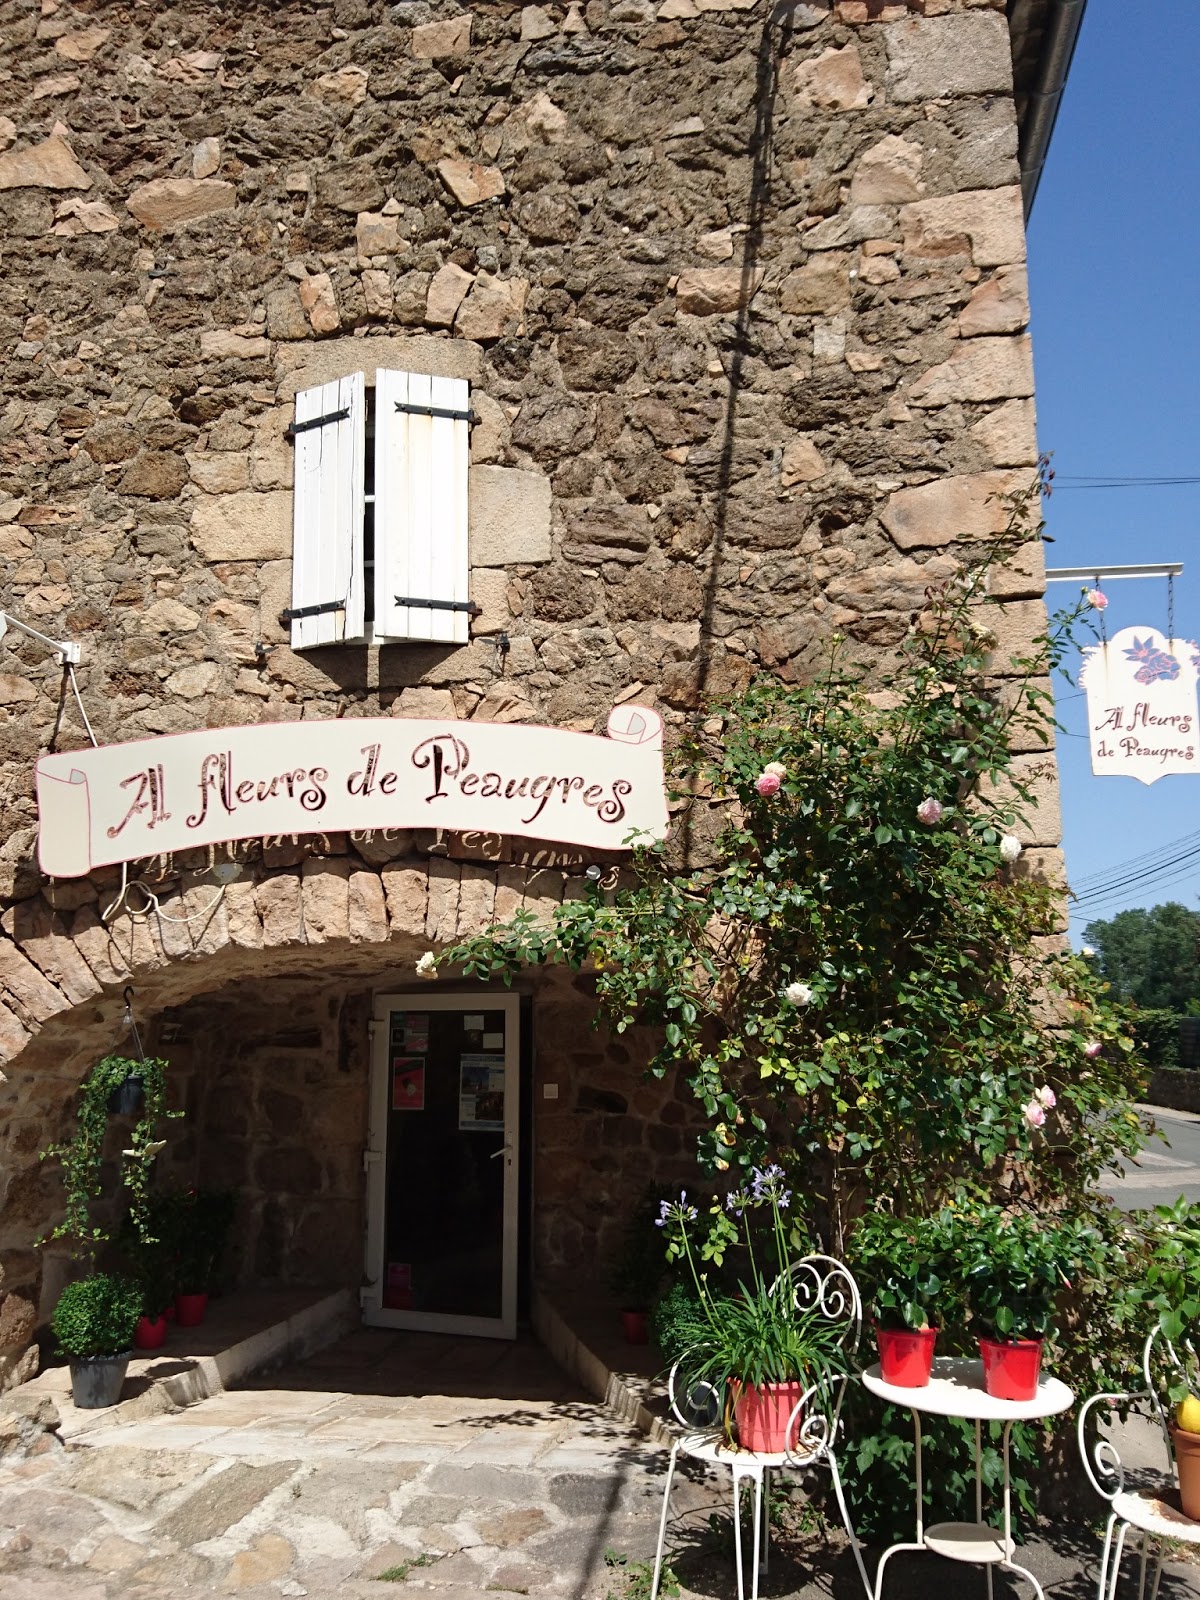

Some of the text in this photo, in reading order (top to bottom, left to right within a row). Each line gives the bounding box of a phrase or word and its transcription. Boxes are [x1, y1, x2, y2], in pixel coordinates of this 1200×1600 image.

[1126, 702, 1192, 733] fleurs
[1097, 736, 1194, 764] de Peaugres
[185, 750, 329, 828] fleurs
[346, 743, 399, 797] de
[410, 732, 633, 824] Peaugres
